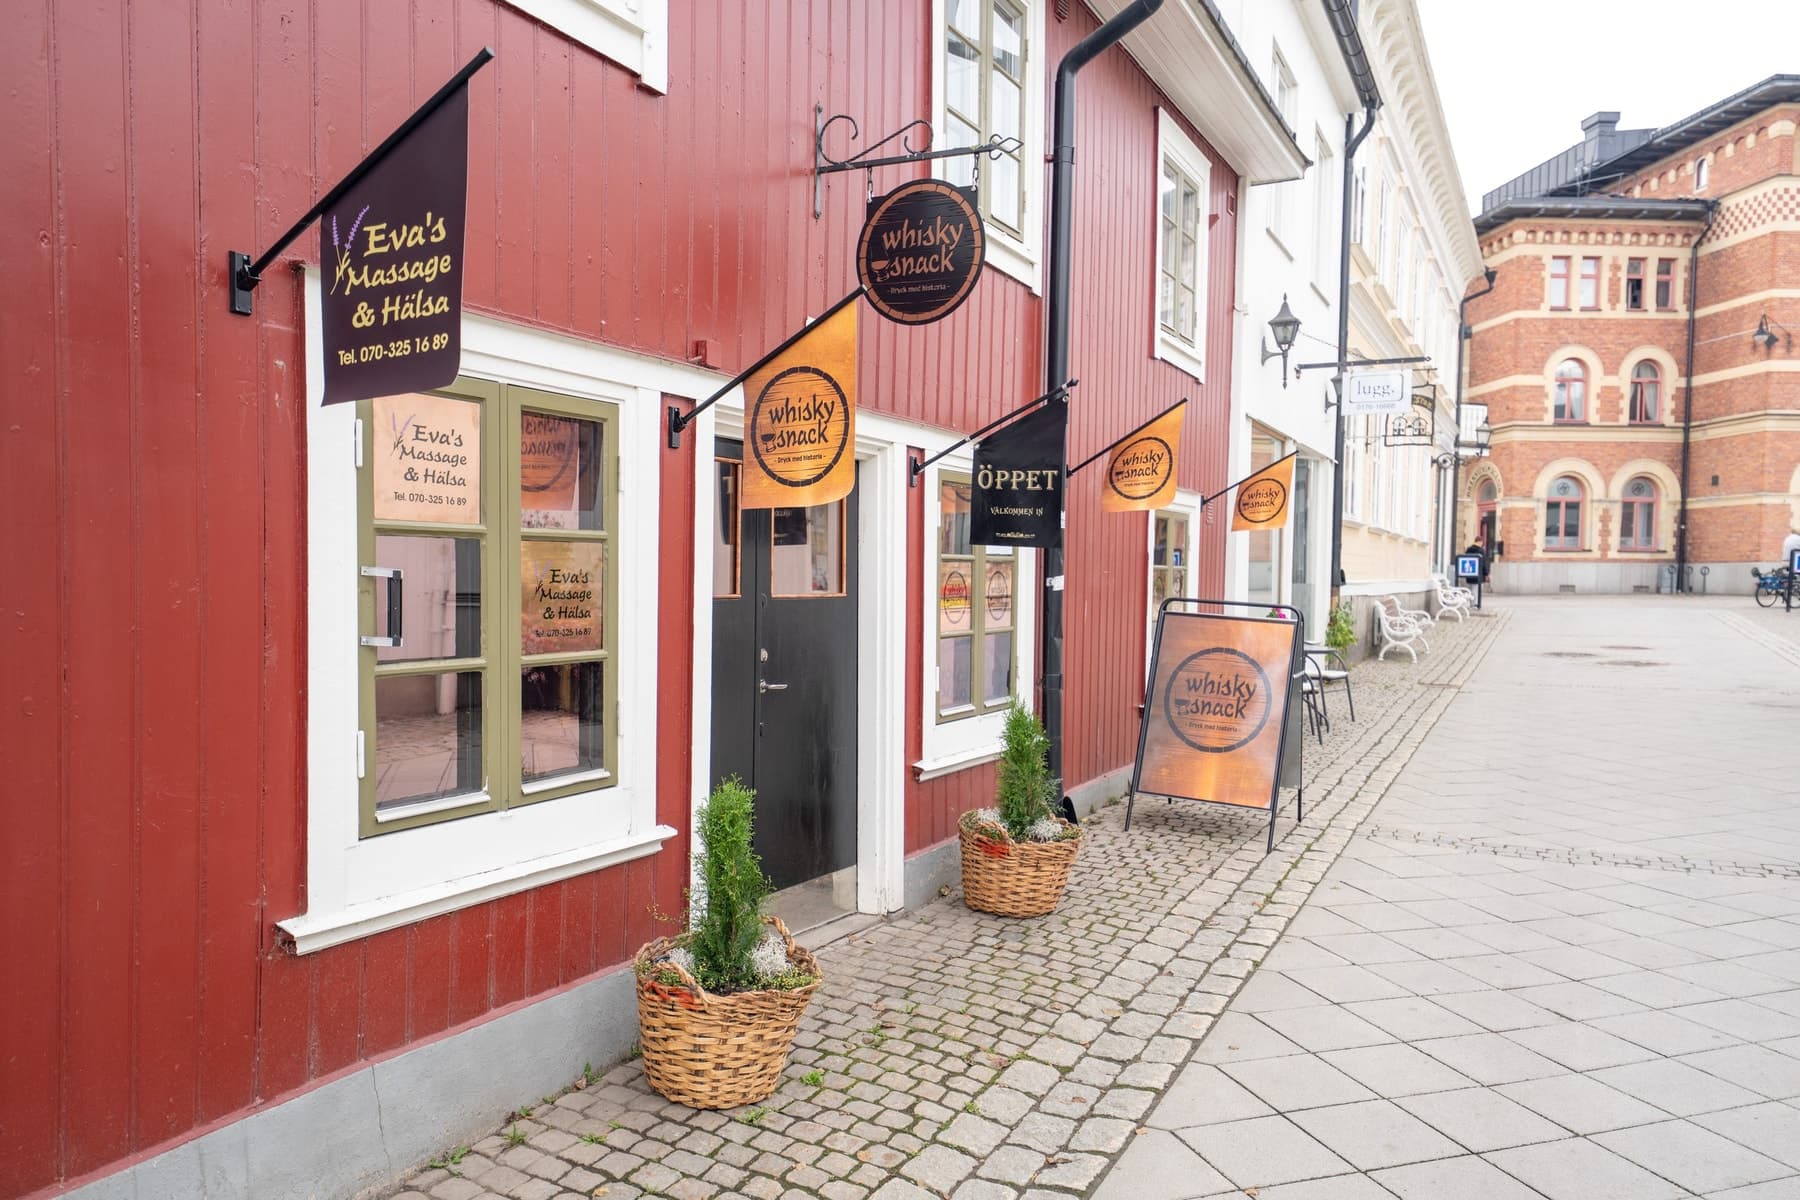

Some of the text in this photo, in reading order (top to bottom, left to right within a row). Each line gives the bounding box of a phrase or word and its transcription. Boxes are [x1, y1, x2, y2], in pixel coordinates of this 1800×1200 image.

[363, 211, 447, 257] Eva's
[881, 215, 964, 250] whisky
[890, 247, 955, 278] snack
[345, 254, 452, 295] Massage
[351, 289, 450, 328] & Hälsa
[338, 333, 449, 366] Tel. 070-325 16 89
[768, 393, 835, 425] whisky
[411, 424, 464, 448] Eva's
[775, 423, 829, 451] snack
[399, 444, 467, 467] Massage
[1122, 449, 1164, 467] whisky
[404, 467, 467, 487] & Hälsa
[978, 464, 1058, 491] ÖPPET
[1123, 463, 1159, 479] snack
[408, 493, 443, 505] 070-325
[445, 495, 455, 505] 16
[456, 497, 467, 506] 89
[1247, 488, 1280, 501] whisky
[1249, 498, 1276, 509] snack
[990, 506, 1044, 517] VÄLKOMMEN IN
[549, 568, 589, 584] Eva's
[540, 588, 592, 603] Massage
[543, 605, 592, 620] & Hälsa
[1186, 671, 1258, 701] whisky
[1189, 698, 1249, 720] snack
